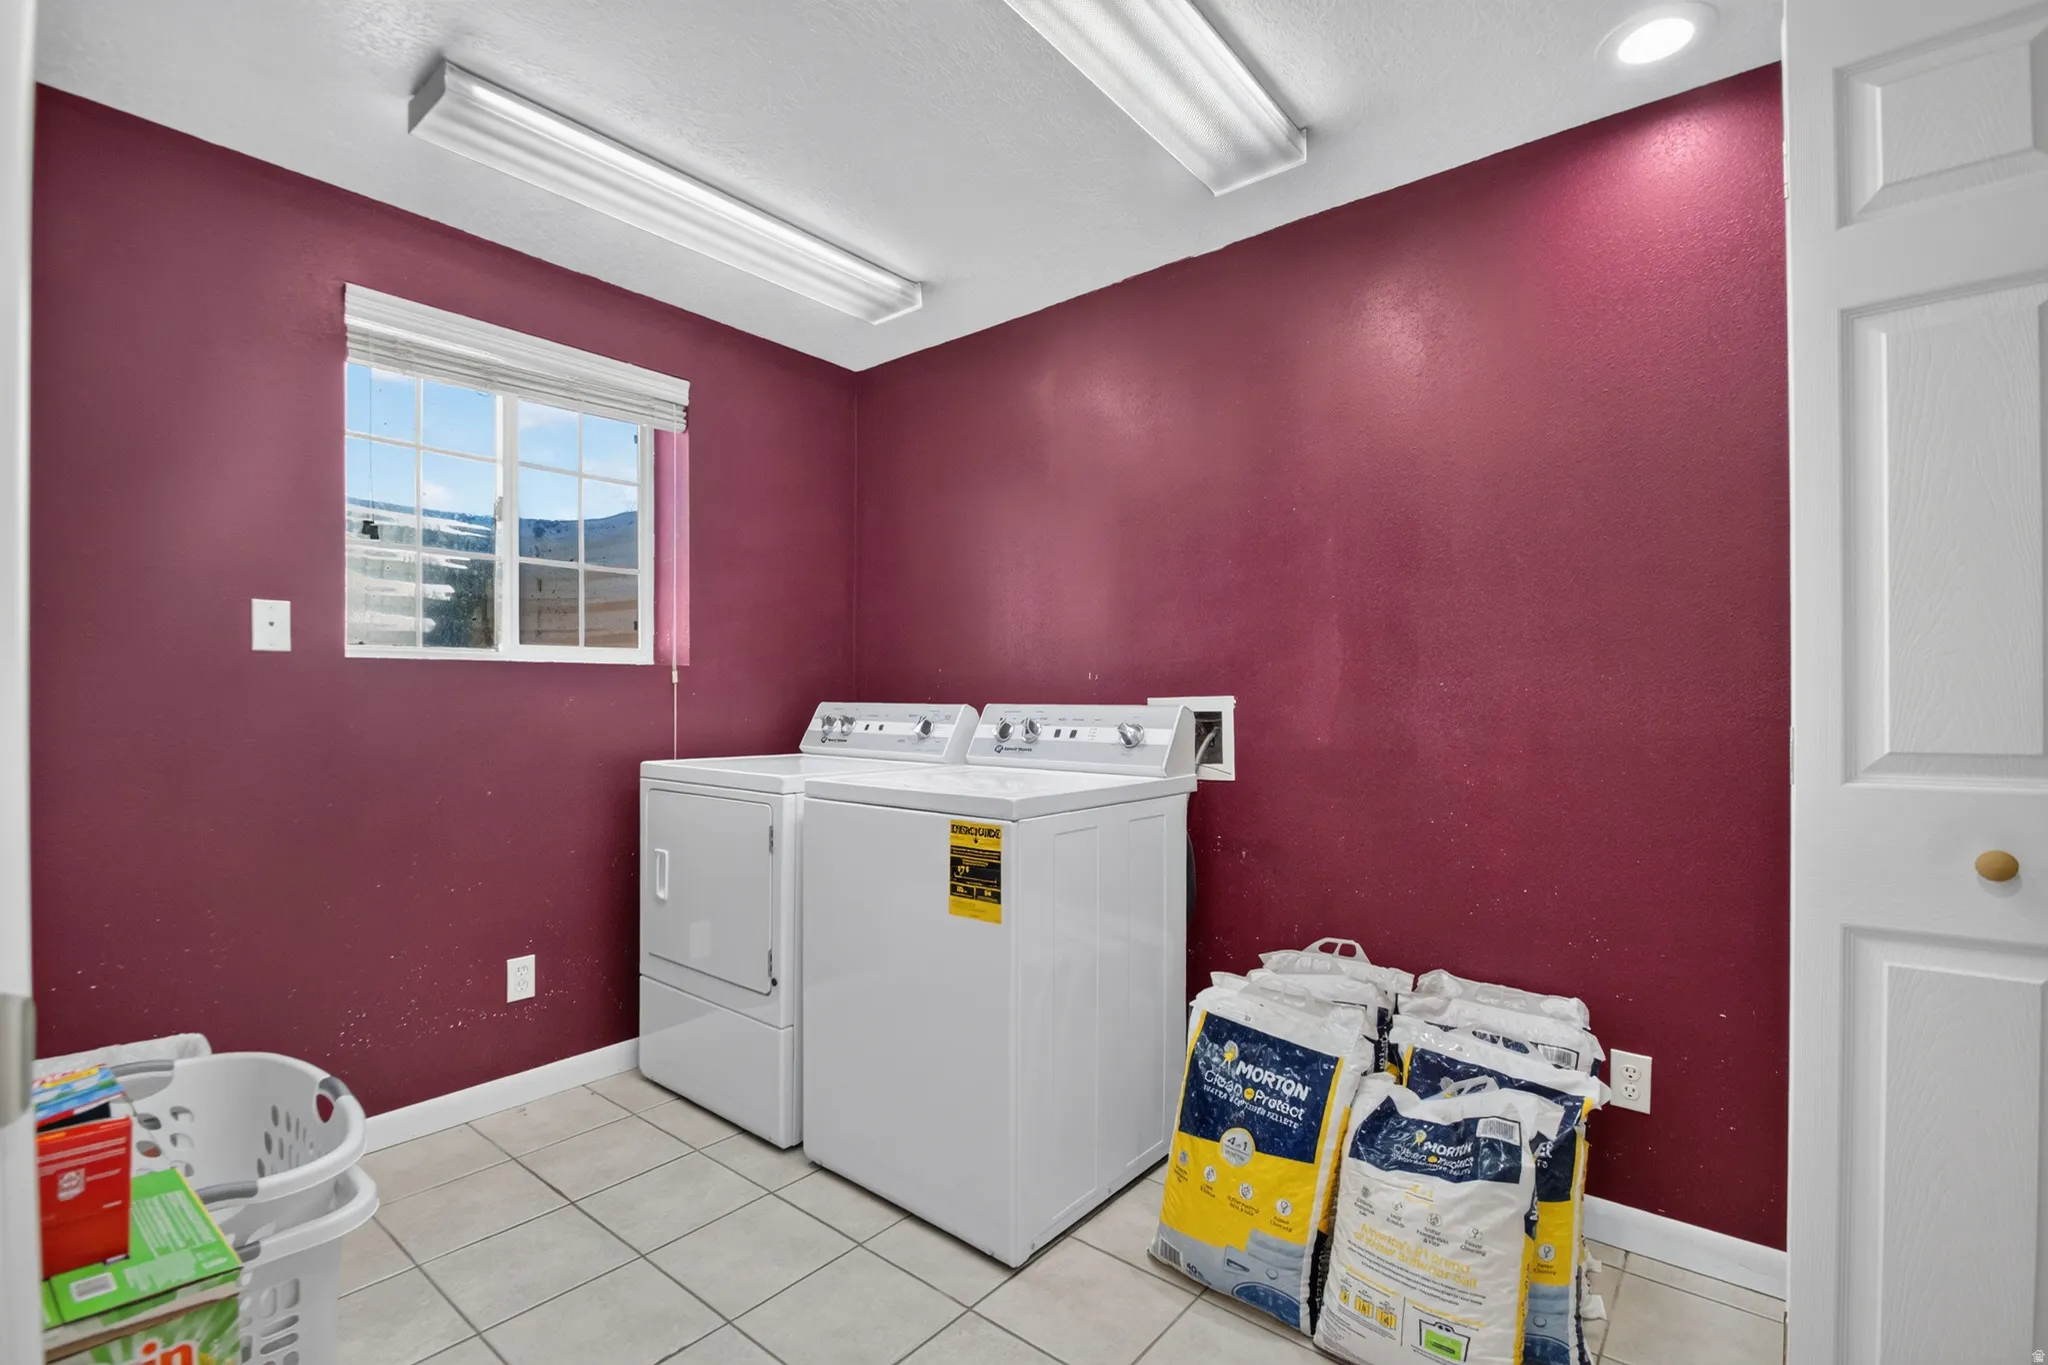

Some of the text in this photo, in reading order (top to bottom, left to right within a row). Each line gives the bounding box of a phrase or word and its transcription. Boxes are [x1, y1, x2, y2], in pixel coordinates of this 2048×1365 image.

[1204, 1070, 1306, 1121] Clean Protect
[1236, 1060, 1309, 1101] MORTON
[1227, 1136, 1236, 1146] 4
[1242, 1141, 1249, 1152] 1
